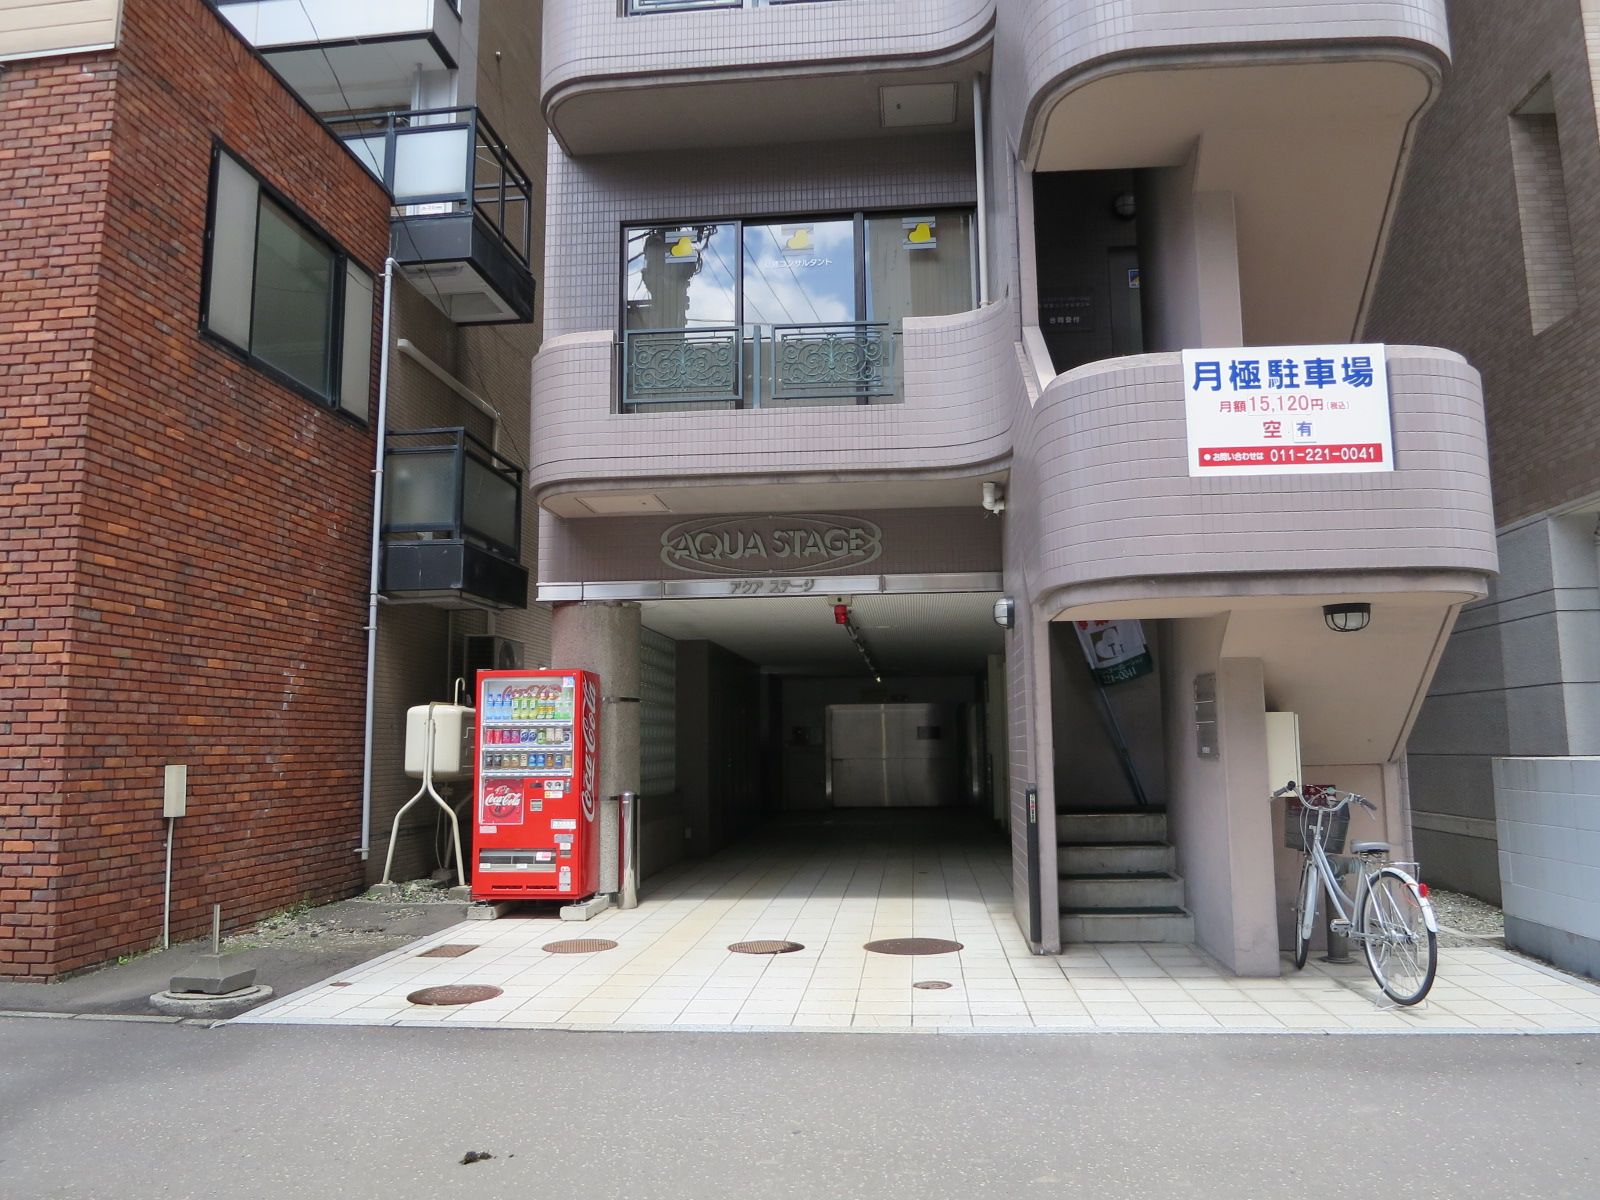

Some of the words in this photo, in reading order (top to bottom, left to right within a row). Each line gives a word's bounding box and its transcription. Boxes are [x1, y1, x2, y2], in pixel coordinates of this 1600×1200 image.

[1192, 355, 1374, 392] 月極駐車場
[1263, 420, 1282, 439] 空
[1296, 420, 1313, 437] 有
[1270, 447, 1375, 462] 011-221-0041
[673, 531, 768, 560] AQUA
[772, 528, 866, 559] STAGE
[728, 580, 764, 595] アクア
[769, 578, 815, 593] ステージ
[485, 792, 522, 806] Coca-Cola
